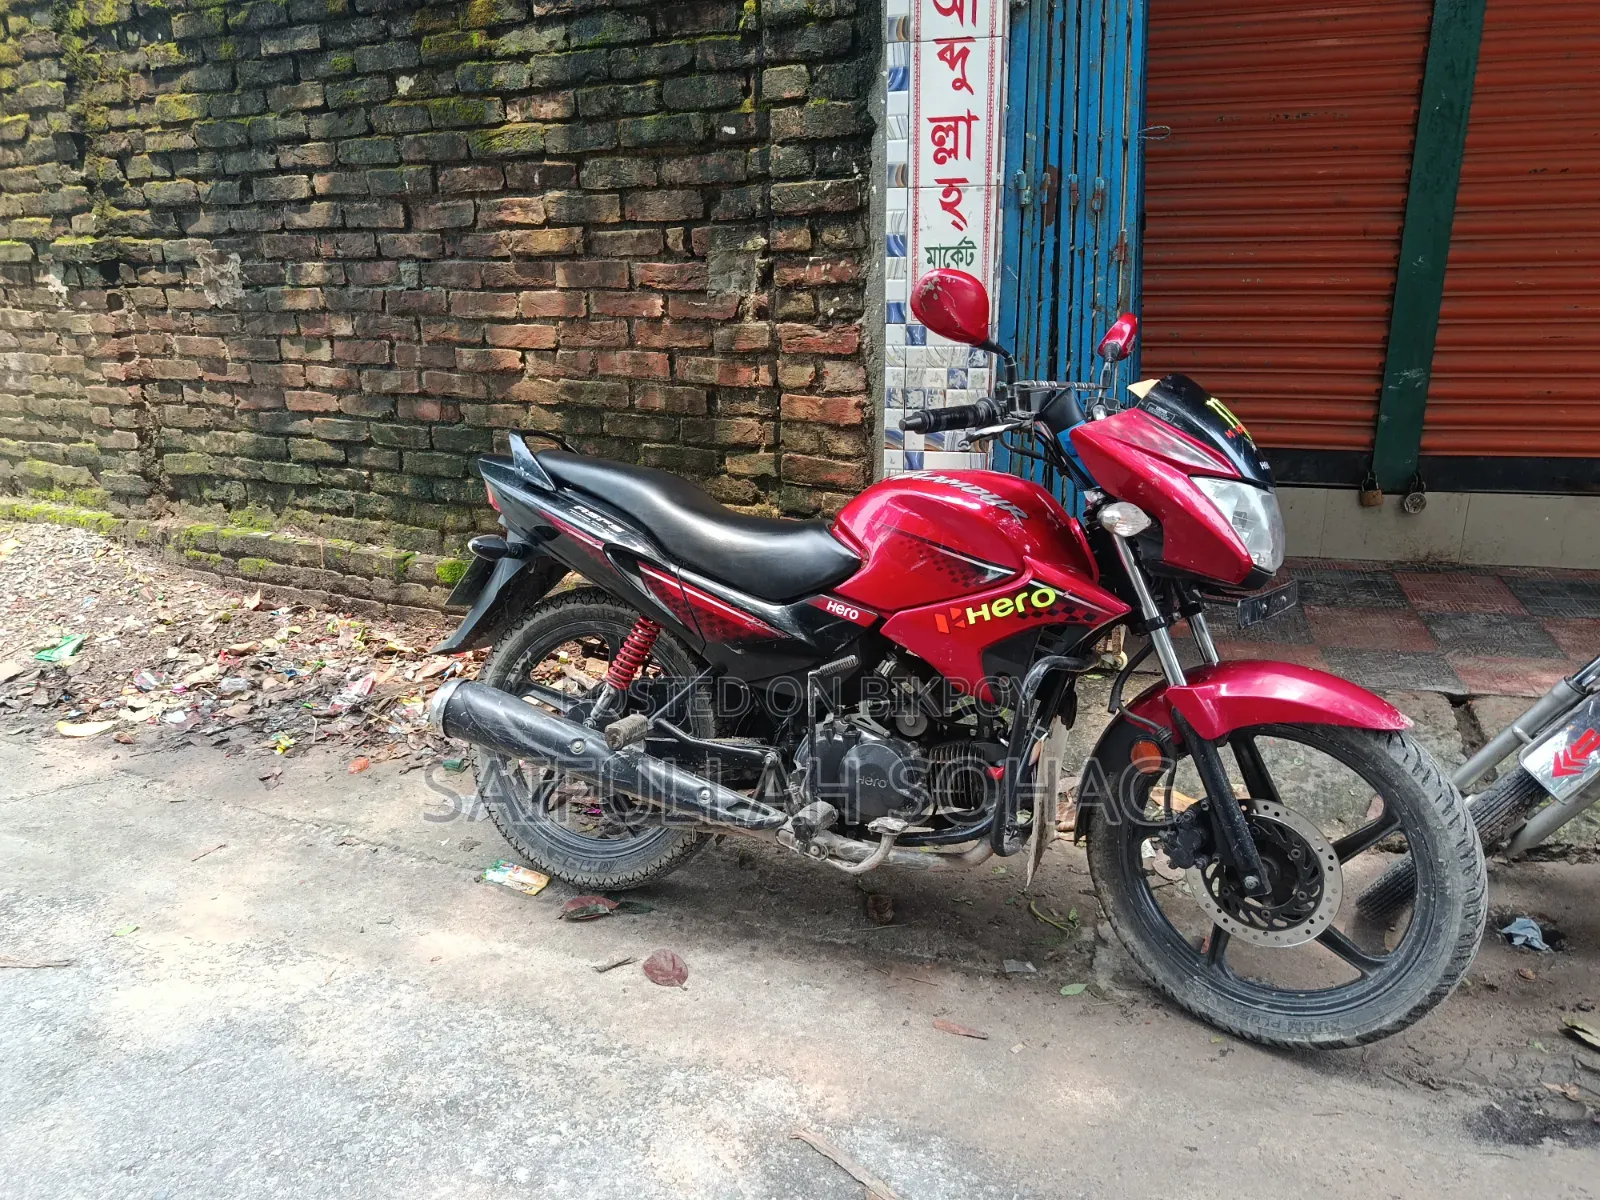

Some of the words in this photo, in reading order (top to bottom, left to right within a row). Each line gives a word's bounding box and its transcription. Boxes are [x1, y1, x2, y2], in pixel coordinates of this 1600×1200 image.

[924, 235, 978, 270] মার্কেট
[826, 601, 859, 620] Hero
[966, 588, 1056, 625] Hero
[856, 775, 888, 789] Hero
